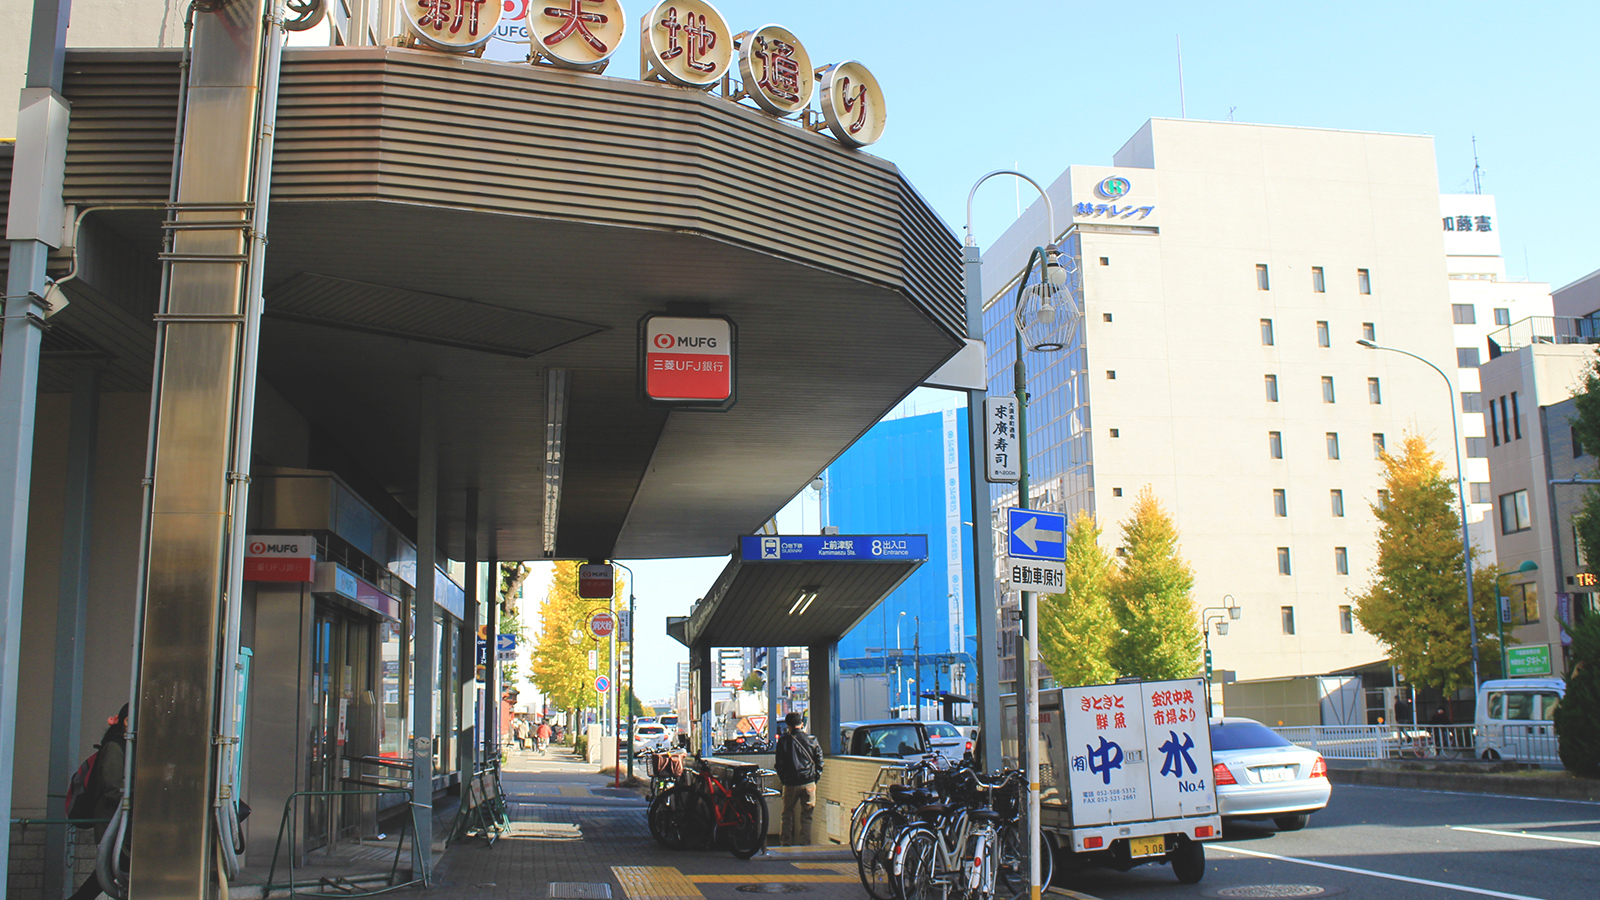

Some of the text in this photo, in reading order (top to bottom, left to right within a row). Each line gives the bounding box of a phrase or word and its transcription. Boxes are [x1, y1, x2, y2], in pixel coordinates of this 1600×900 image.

[492, 25, 529, 37] UFG
[677, 336, 717, 348] MUFG
[653, 359, 724, 372] 三菱UFJ銀行
[266, 544, 298, 553] MUFG
[821, 540, 854, 550] 上前津駅
[871, 539, 883, 556] 8
[882, 540, 907, 550] 出入口
[249, 562, 303, 572] 三菱UFJ銀行
[592, 620, 613, 630] 消火栓
[1081, 694, 1126, 712] きときと
[1151, 689, 1194, 708] 金沢中央
[1095, 712, 1127, 730] 鮮魚
[1153, 708, 1196, 726] 市場より
[1178, 779, 1206, 793] No.4
